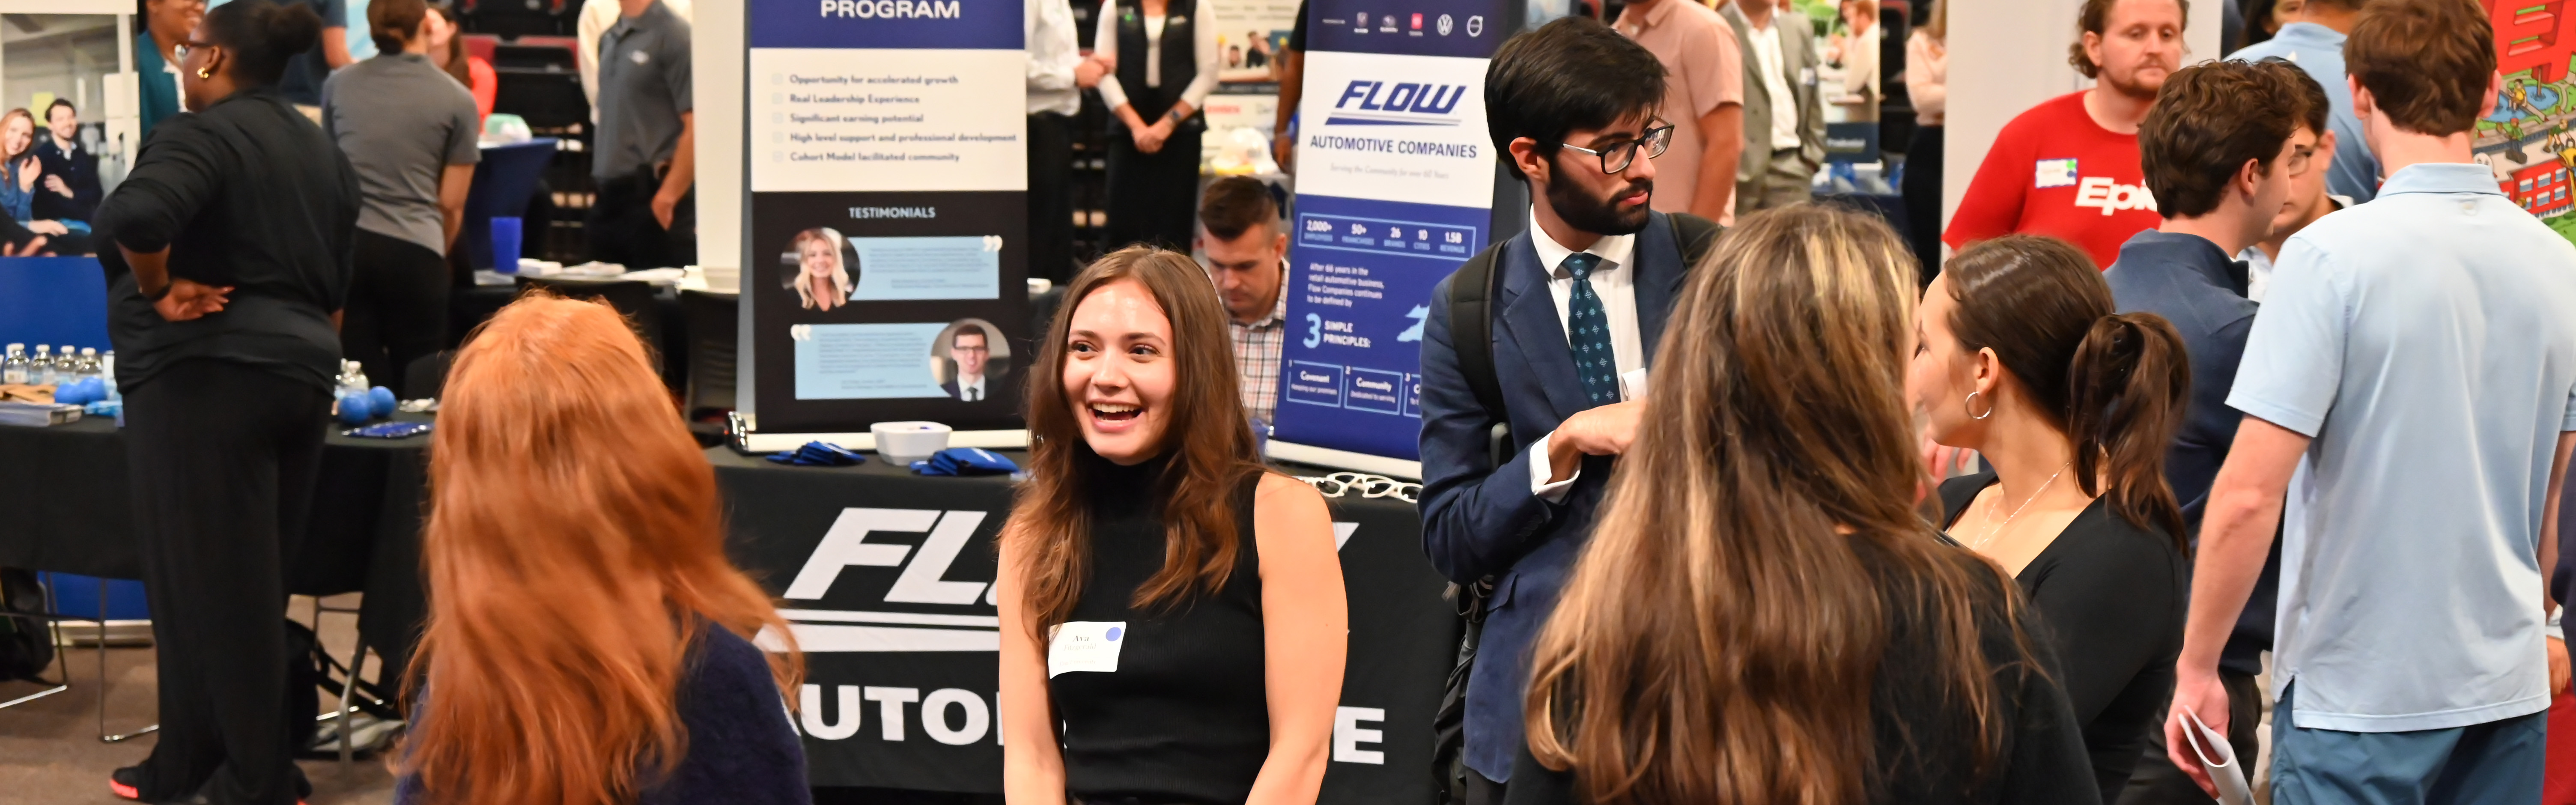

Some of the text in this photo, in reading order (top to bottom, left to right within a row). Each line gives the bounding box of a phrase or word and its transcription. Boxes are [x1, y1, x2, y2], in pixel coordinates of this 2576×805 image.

[821, 0, 960, 18] PROGRAM
[790, 75, 959, 86] Opportunity for accelerated growth
[790, 93, 920, 104] Real Leadership Experience
[1335, 80, 1467, 114] FLOW
[790, 113, 924, 124] Significant earning potential
[790, 132, 1016, 143] High level support and professional development
[1310, 135, 1477, 158] AUTOMOTIVE COMPANIES
[790, 152, 960, 163] Cohort Model facilitated community
[849, 207, 936, 219] TESTIMONIALS
[1418, 229, 1428, 241] 10
[1303, 313, 1354, 349] 3 SIMPLE
[1323, 333, 1371, 348] PRINCIPLES:
[1404, 373, 1410, 382] 3
